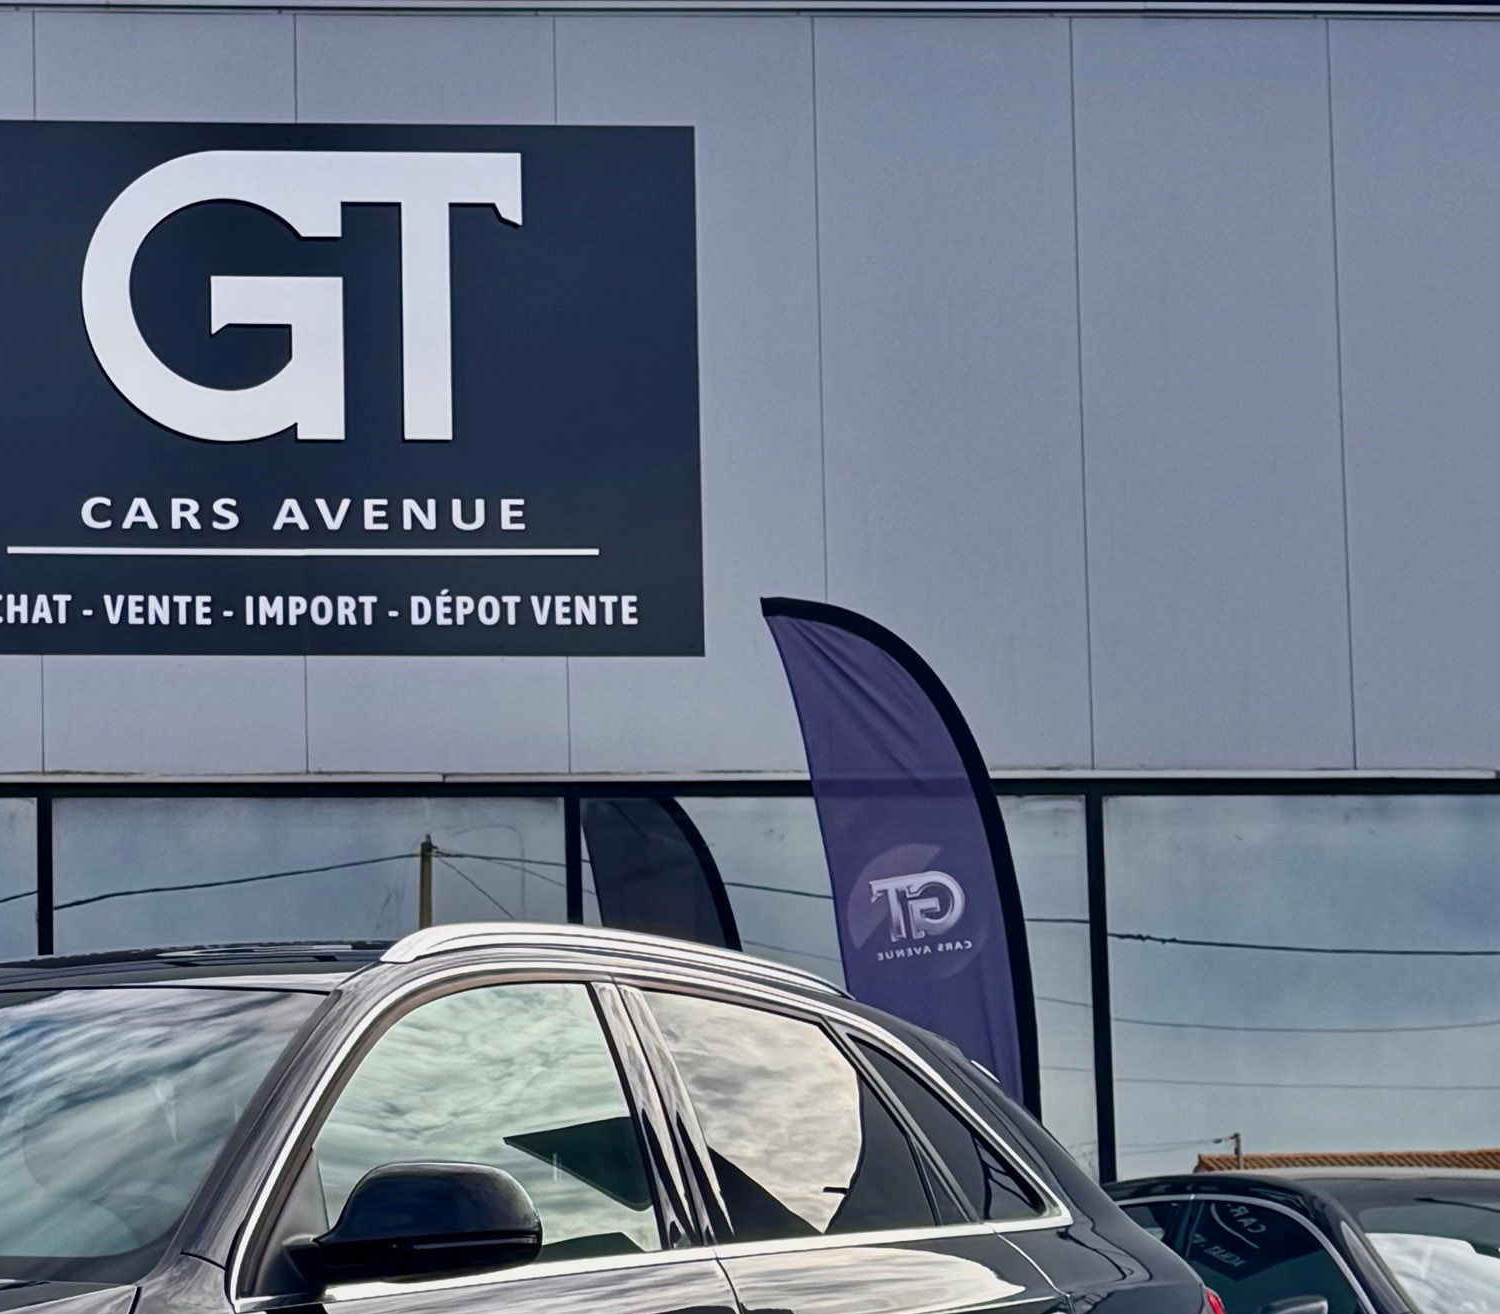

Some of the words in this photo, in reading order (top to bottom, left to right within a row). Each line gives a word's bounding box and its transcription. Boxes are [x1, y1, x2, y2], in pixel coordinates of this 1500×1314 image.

[81, 150, 523, 442] GT
[80, 496, 240, 531] CARS
[272, 498, 527, 532] AVENUE
[103, 594, 213, 626] VENTE
[245, 595, 379, 627] IMPORT
[410, 588, 521, 627] DÉPOT
[530, 595, 639, 627] VENTE
